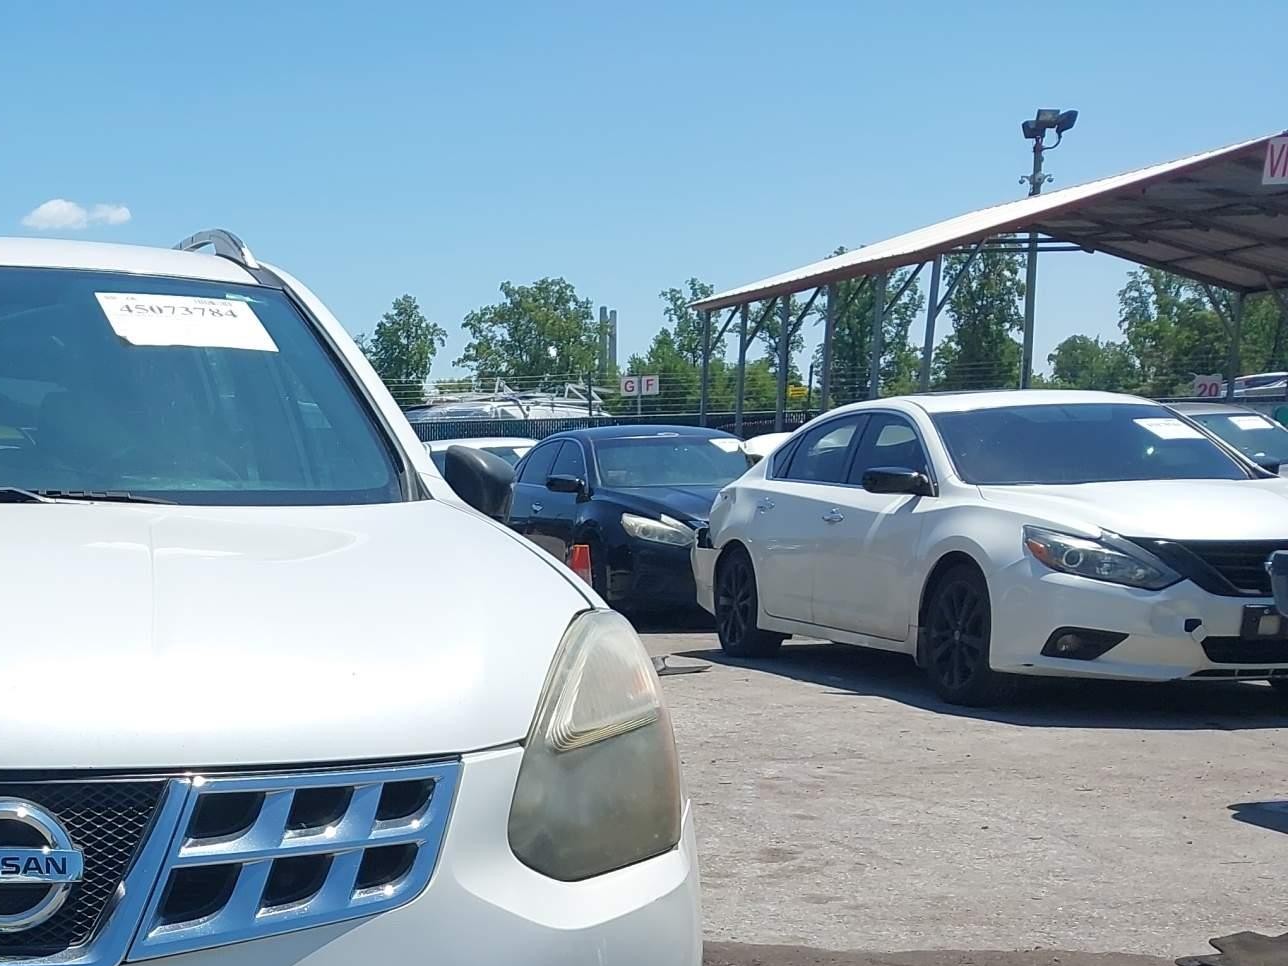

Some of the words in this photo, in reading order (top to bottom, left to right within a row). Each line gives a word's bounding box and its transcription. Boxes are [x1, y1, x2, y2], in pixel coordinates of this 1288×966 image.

[119, 303, 238, 319] 45073784
[624, 380, 635, 393] G
[646, 378, 655, 392] F
[1197, 382, 1219, 397] 20
